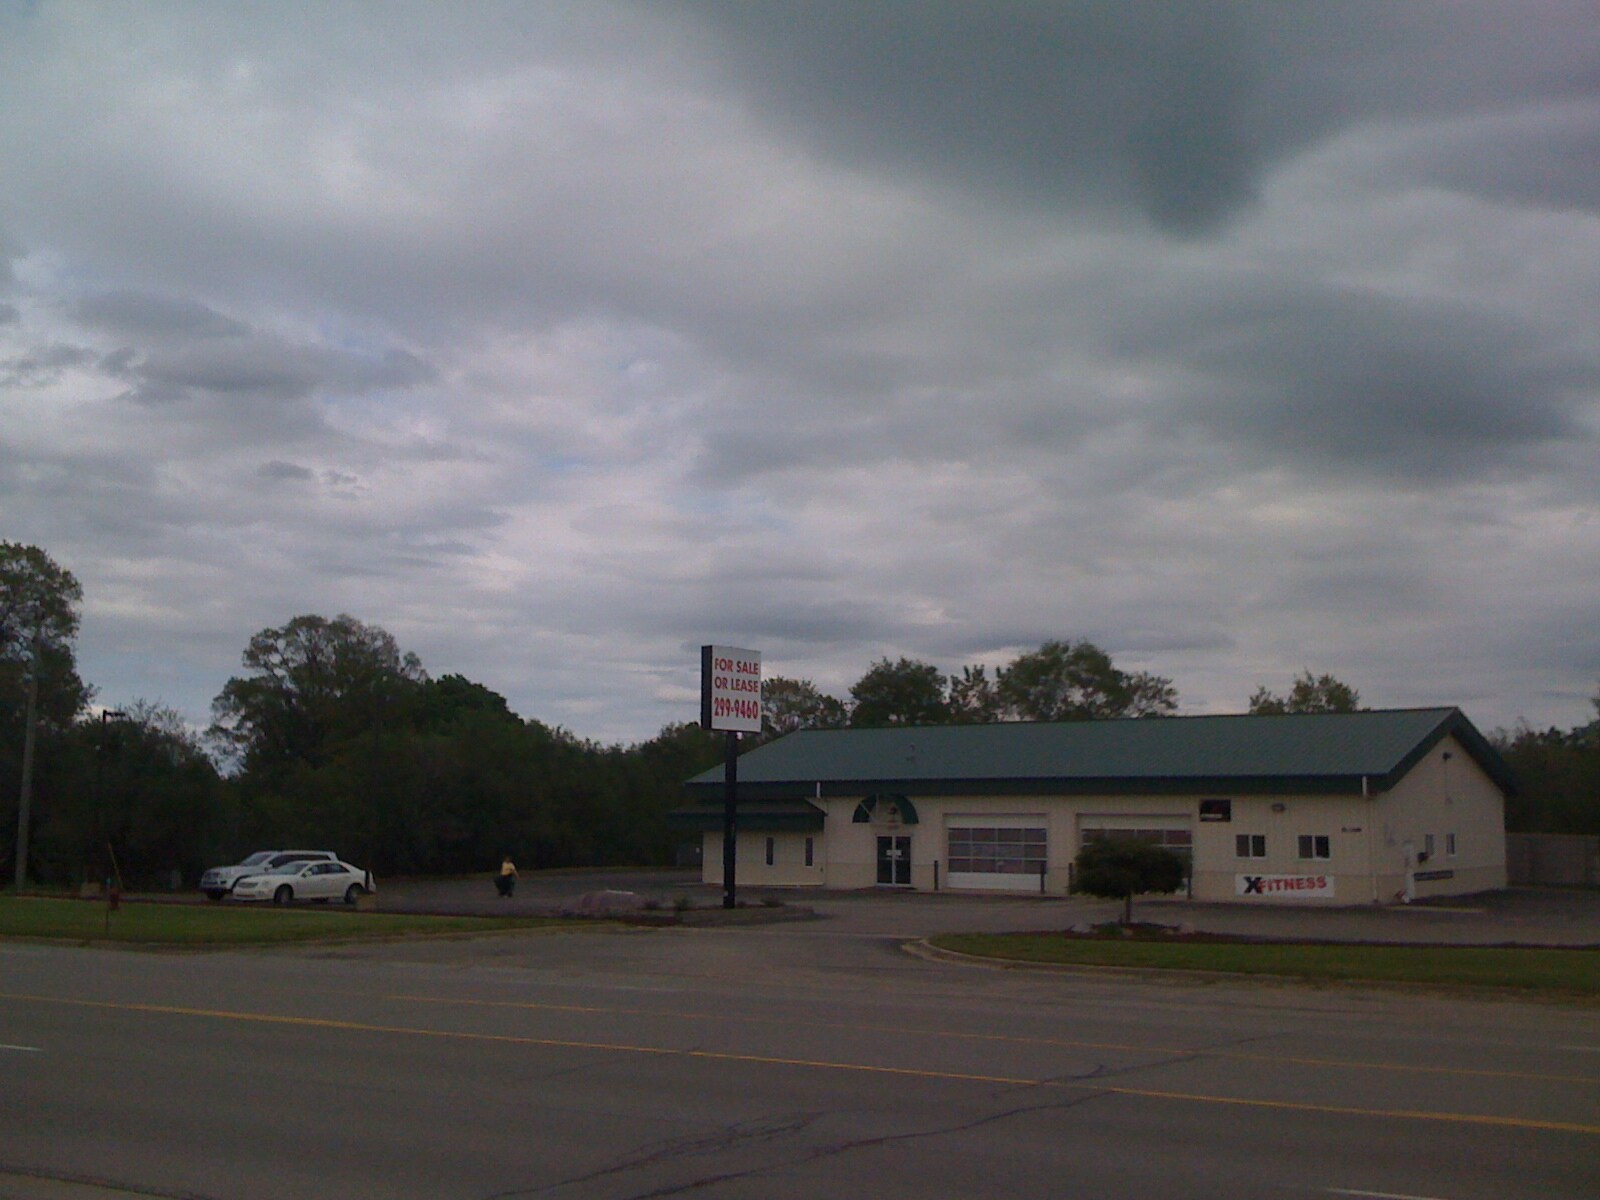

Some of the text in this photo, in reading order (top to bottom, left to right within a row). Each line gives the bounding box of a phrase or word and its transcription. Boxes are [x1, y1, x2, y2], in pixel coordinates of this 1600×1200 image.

[714, 658, 759, 675] FOR SALE
[714, 676, 759, 693] OR LEASE
[714, 697, 759, 719] 299-9460
